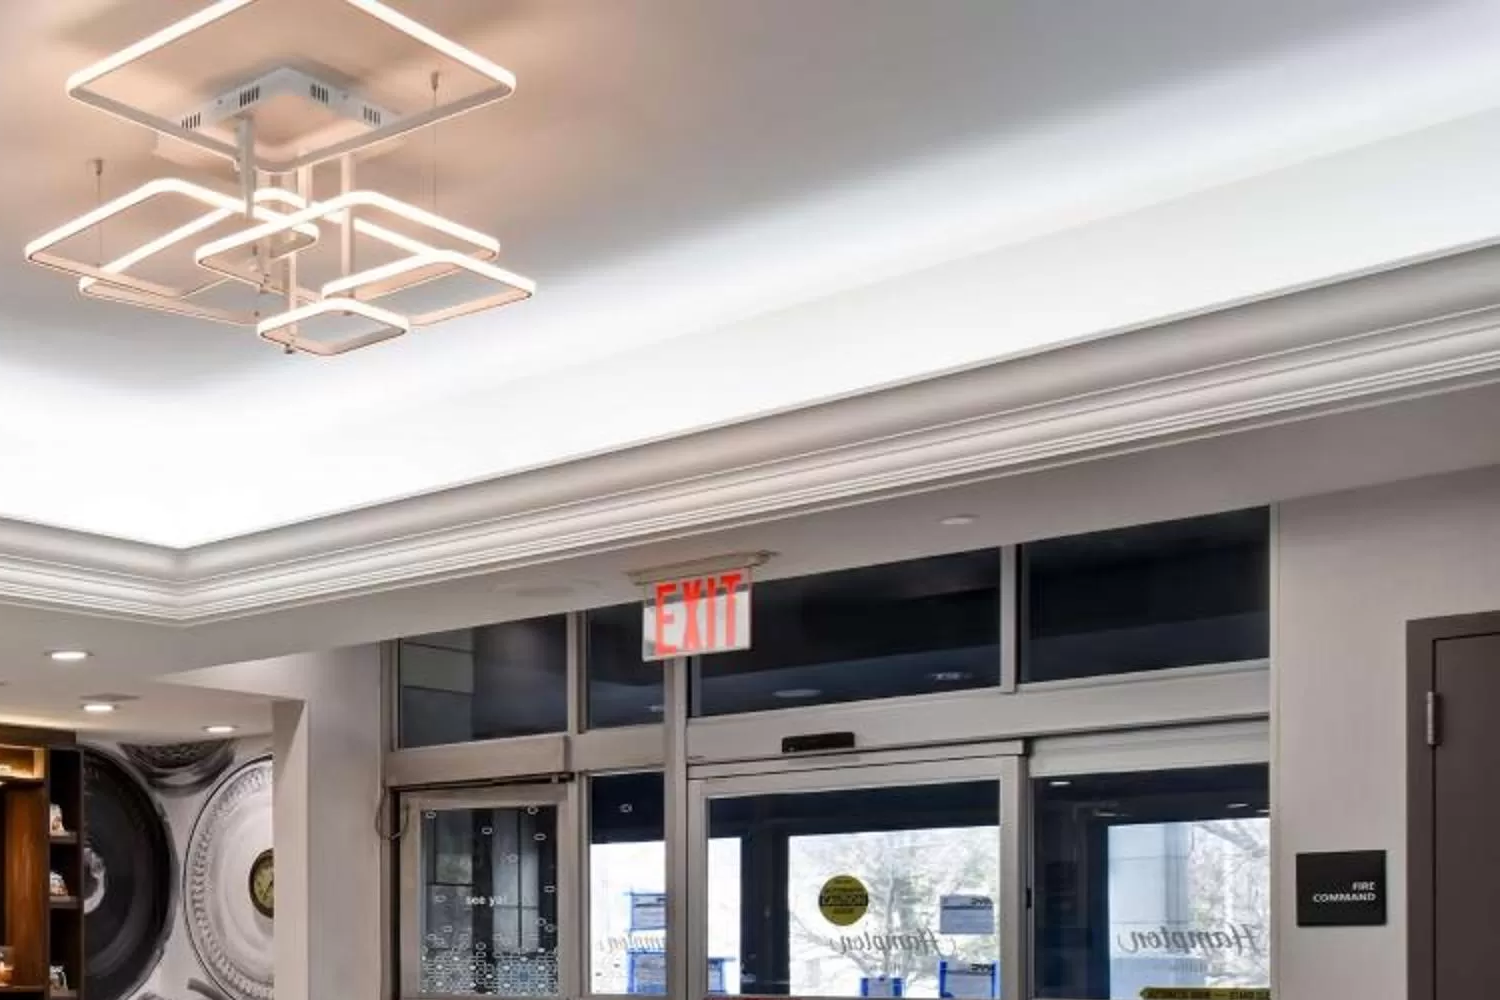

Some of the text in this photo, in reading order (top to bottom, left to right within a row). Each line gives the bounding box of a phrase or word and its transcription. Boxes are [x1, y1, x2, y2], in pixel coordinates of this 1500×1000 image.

[655, 574, 742, 656] EXIT
[1352, 881, 1375, 891] FIRE
[1313, 892, 1377, 902] COMMAND
